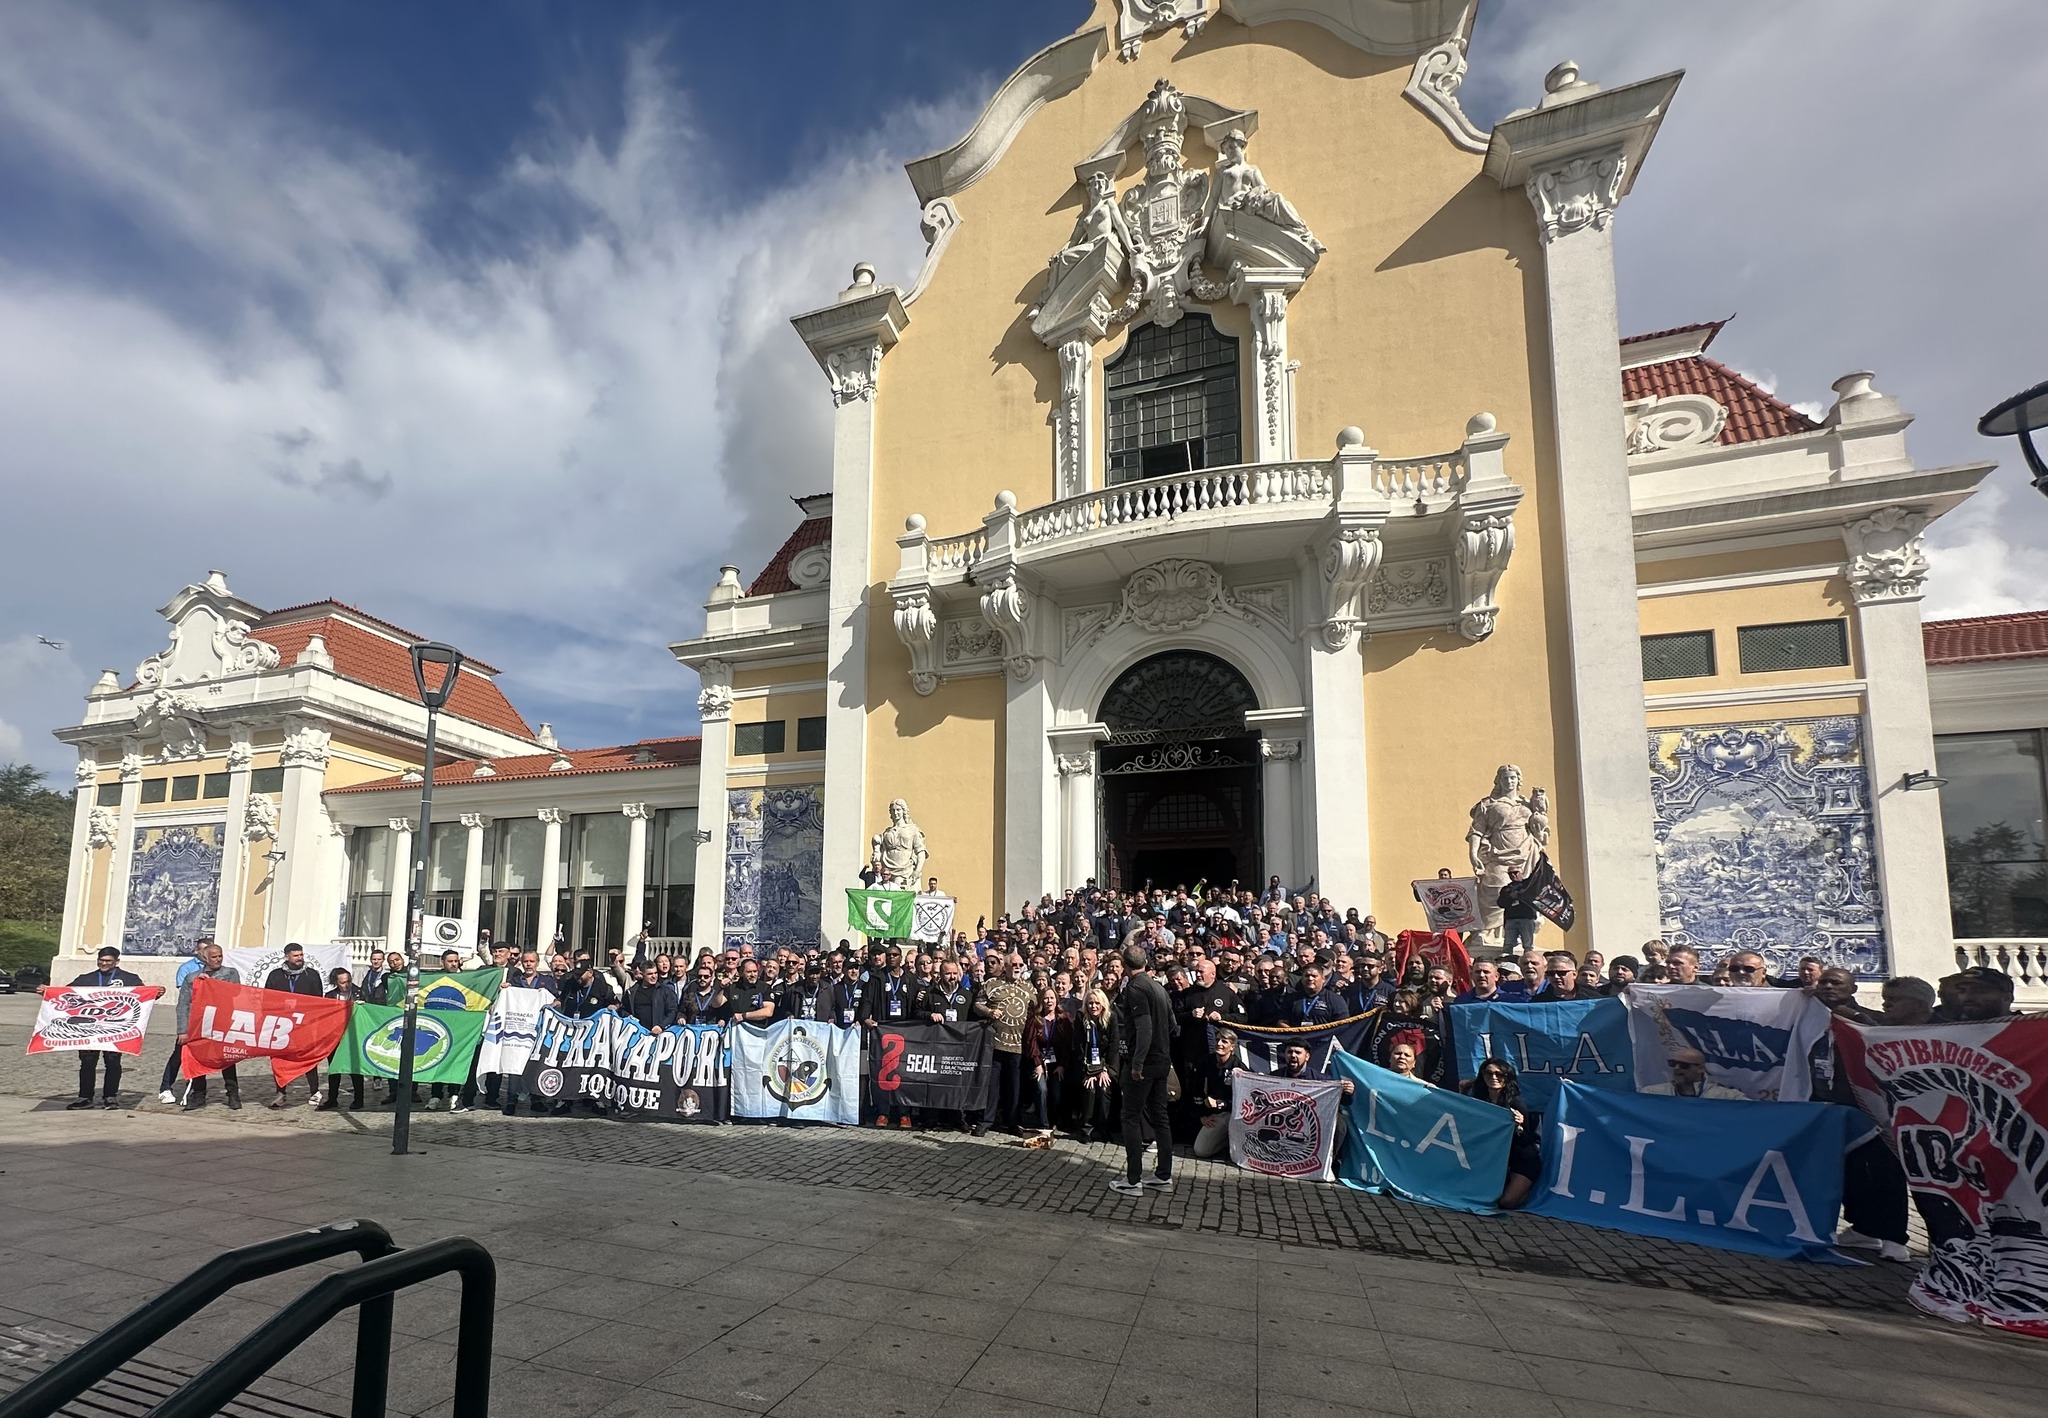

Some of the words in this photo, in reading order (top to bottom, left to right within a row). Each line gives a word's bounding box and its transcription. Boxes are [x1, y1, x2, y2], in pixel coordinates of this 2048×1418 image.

[81, 1001, 125, 1016] IDC
[201, 1005, 294, 1050] LAB
[45, 1038, 90, 1047] QUINTERO
[97, 1029, 139, 1044] VENTANAS
[223, 1045, 248, 1055] EUSKAL
[905, 1053, 938, 1074] SEAL
[1866, 1038, 2025, 1091] ESTIBADORES
[1264, 1109, 1304, 1129] IDC
[1549, 1121, 1827, 1244] I.L.A
